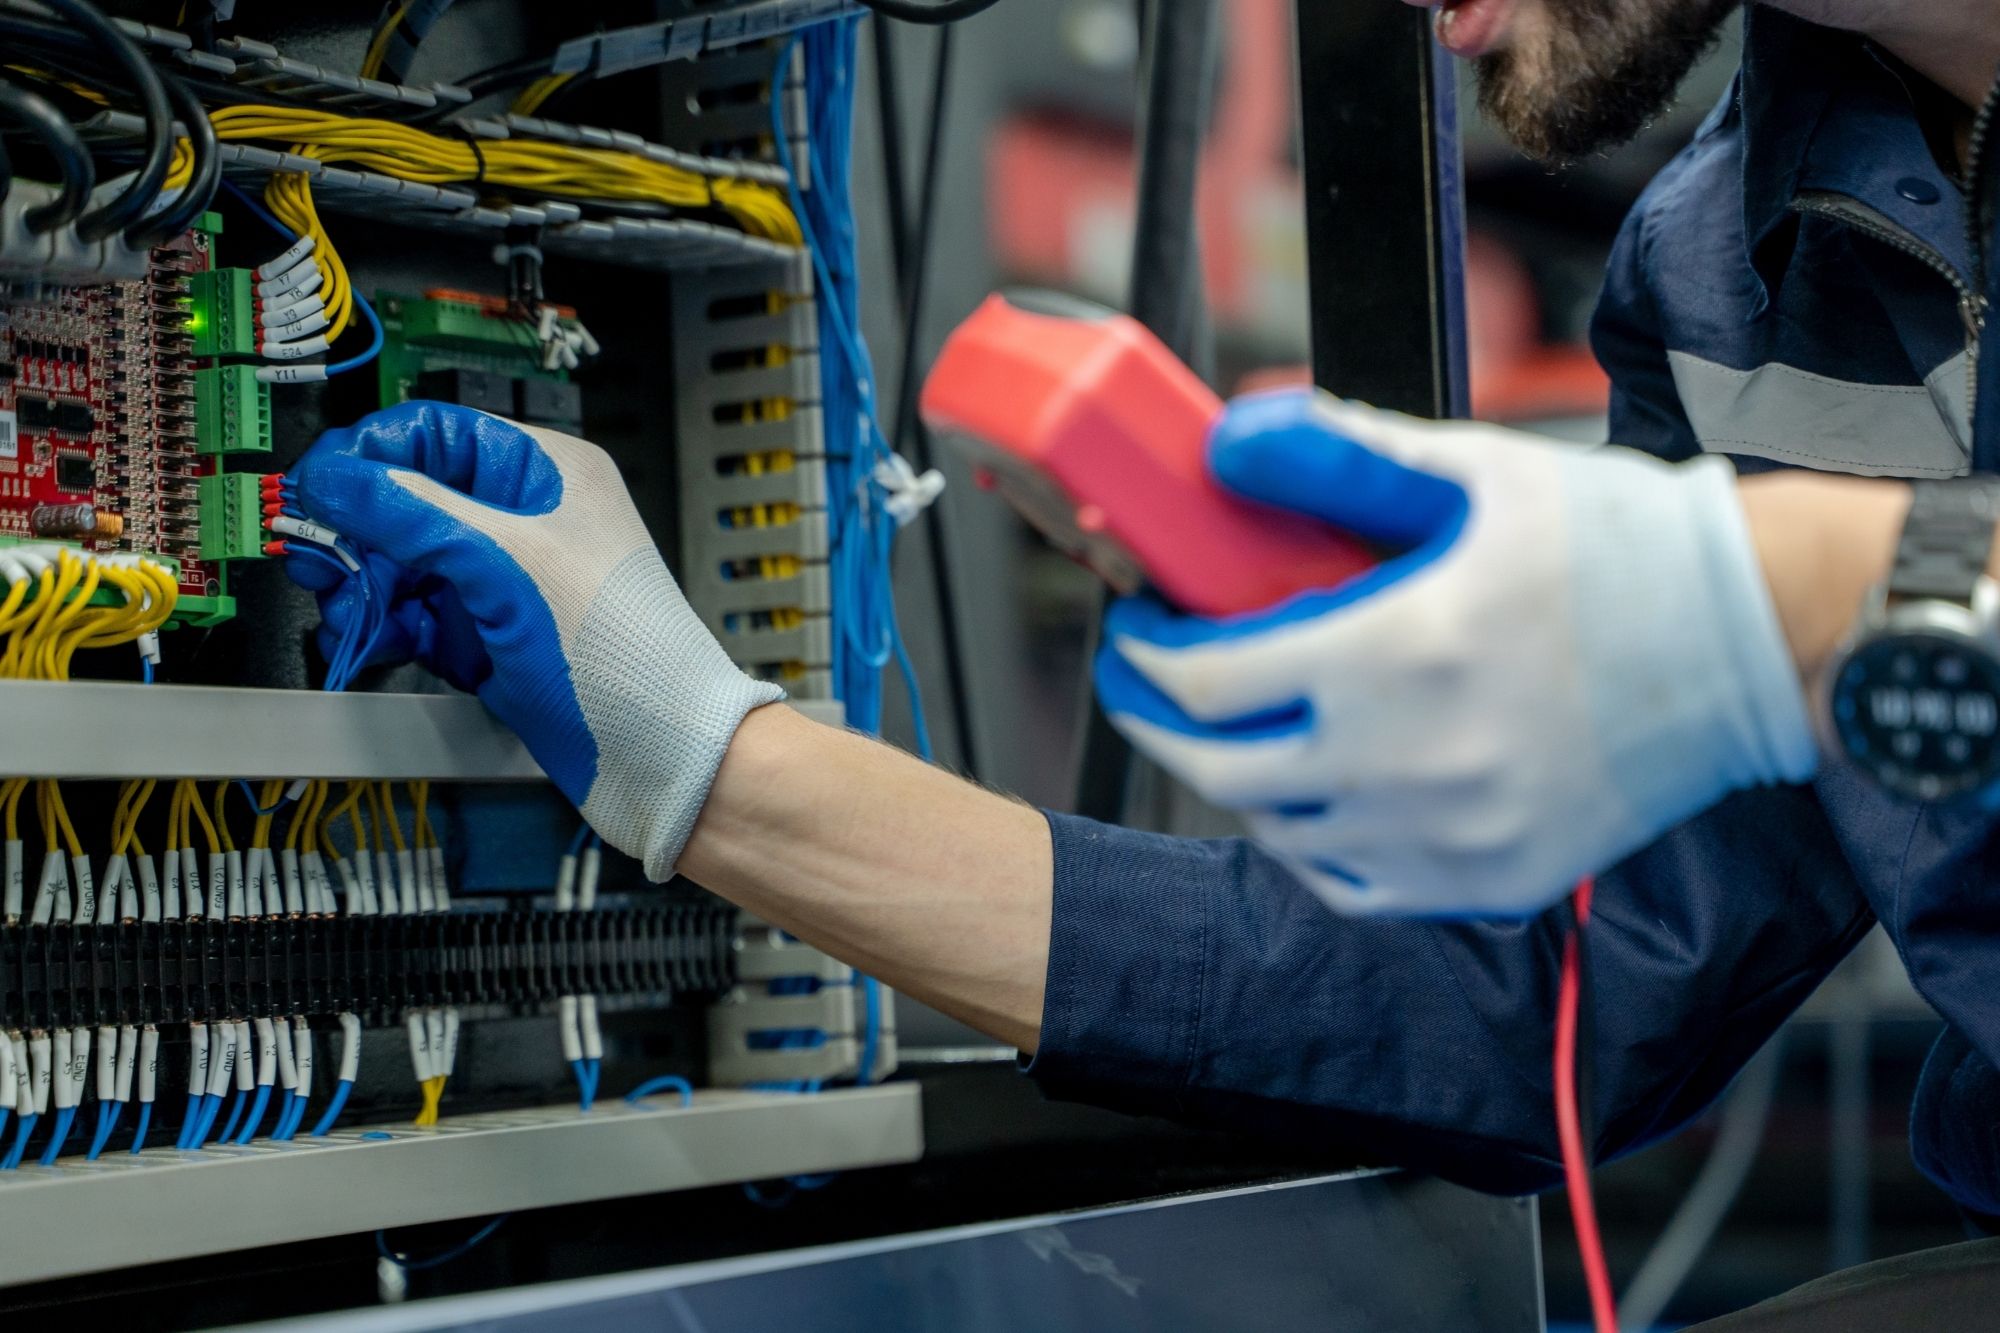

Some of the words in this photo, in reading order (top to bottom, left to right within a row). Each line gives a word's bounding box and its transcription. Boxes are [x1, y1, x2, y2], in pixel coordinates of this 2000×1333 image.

[279, 273, 290, 285] Y7
[284, 308, 298, 321] Y9
[275, 369, 297, 380] Y11
[297, 523, 317, 539] Y19
[223, 1043, 237, 1073] EGND
[73, 1054, 87, 1082] EGND
